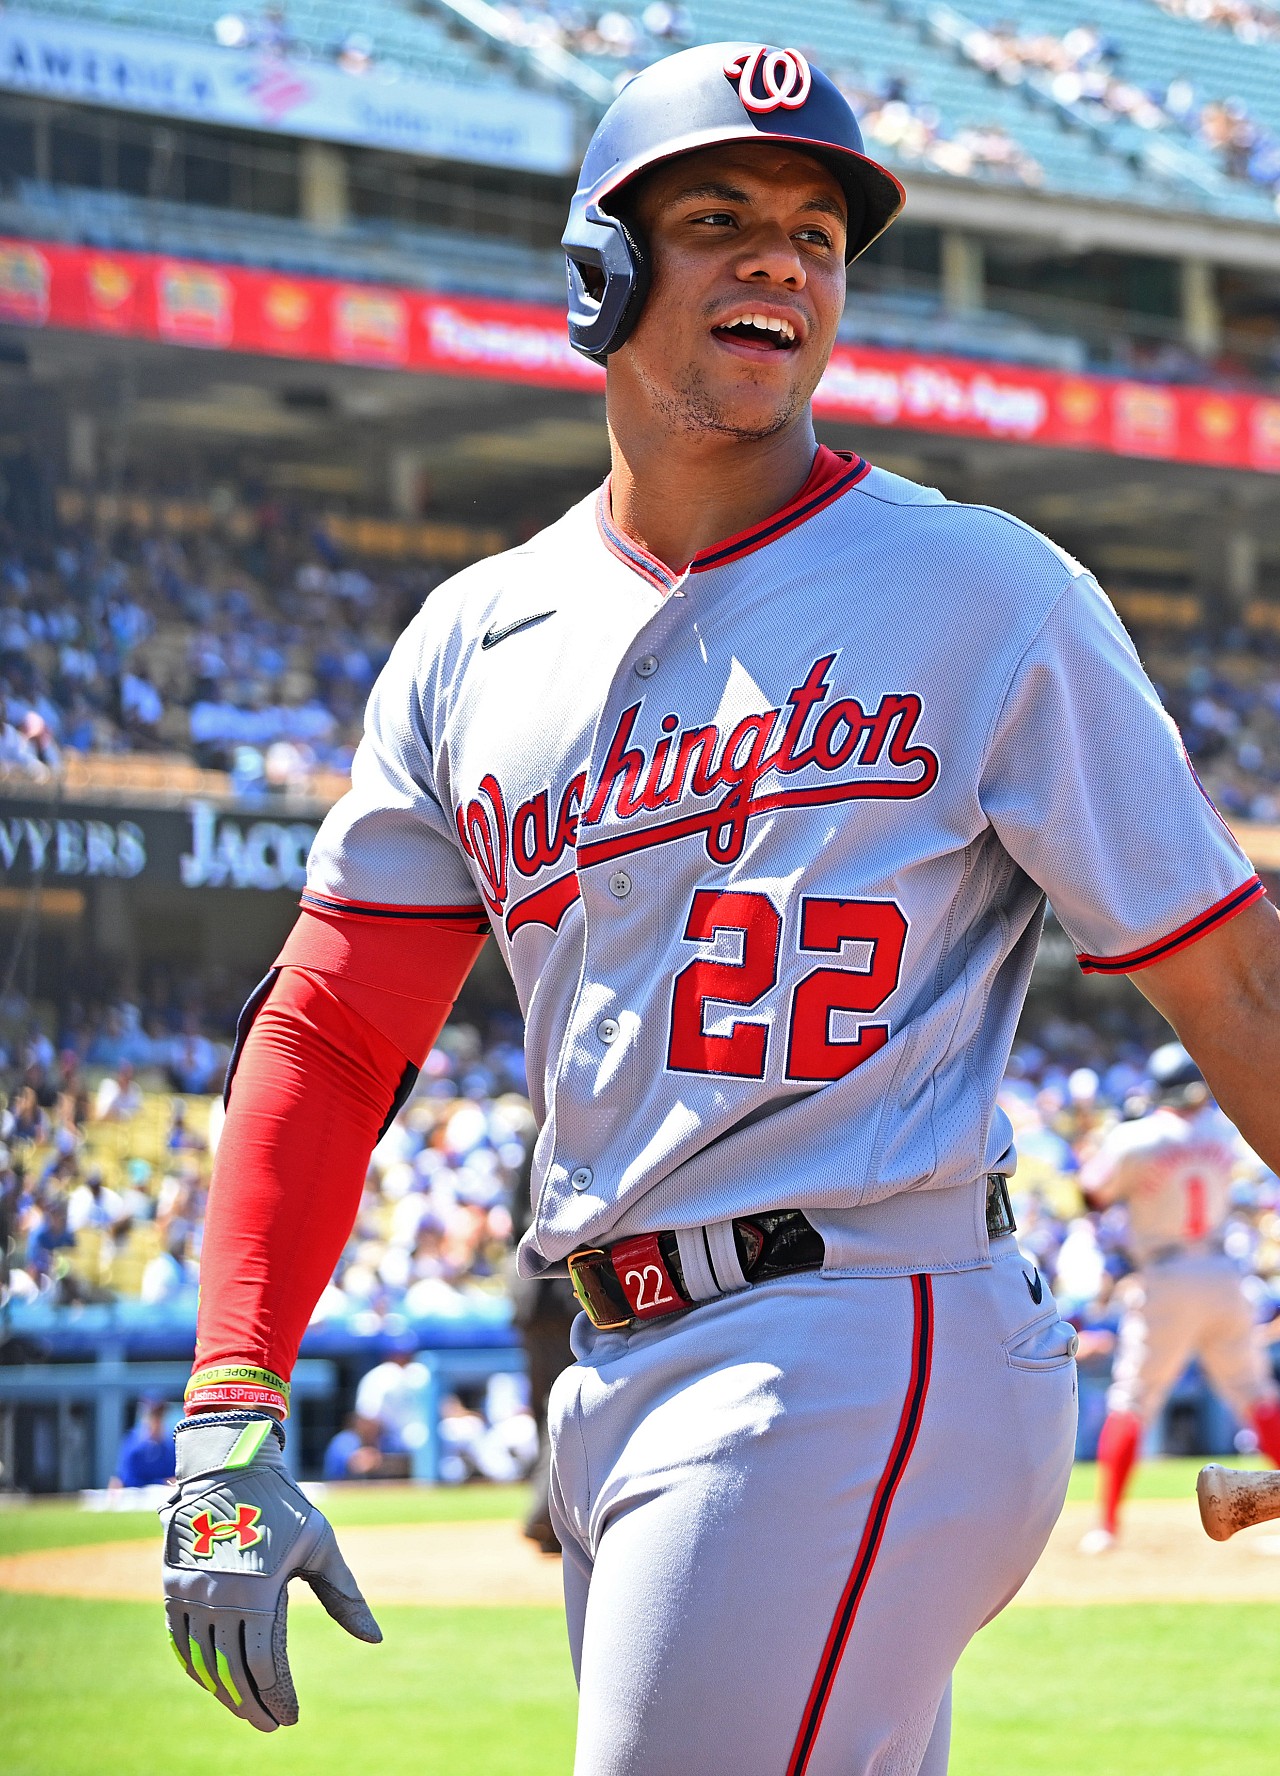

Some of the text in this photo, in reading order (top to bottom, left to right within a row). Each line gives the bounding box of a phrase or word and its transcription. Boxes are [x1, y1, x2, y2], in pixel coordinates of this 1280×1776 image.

[723, 47, 812, 114] W
[456, 648, 939, 940] Washington
[666, 885, 909, 1083] 22
[625, 1265, 673, 1311] 22
